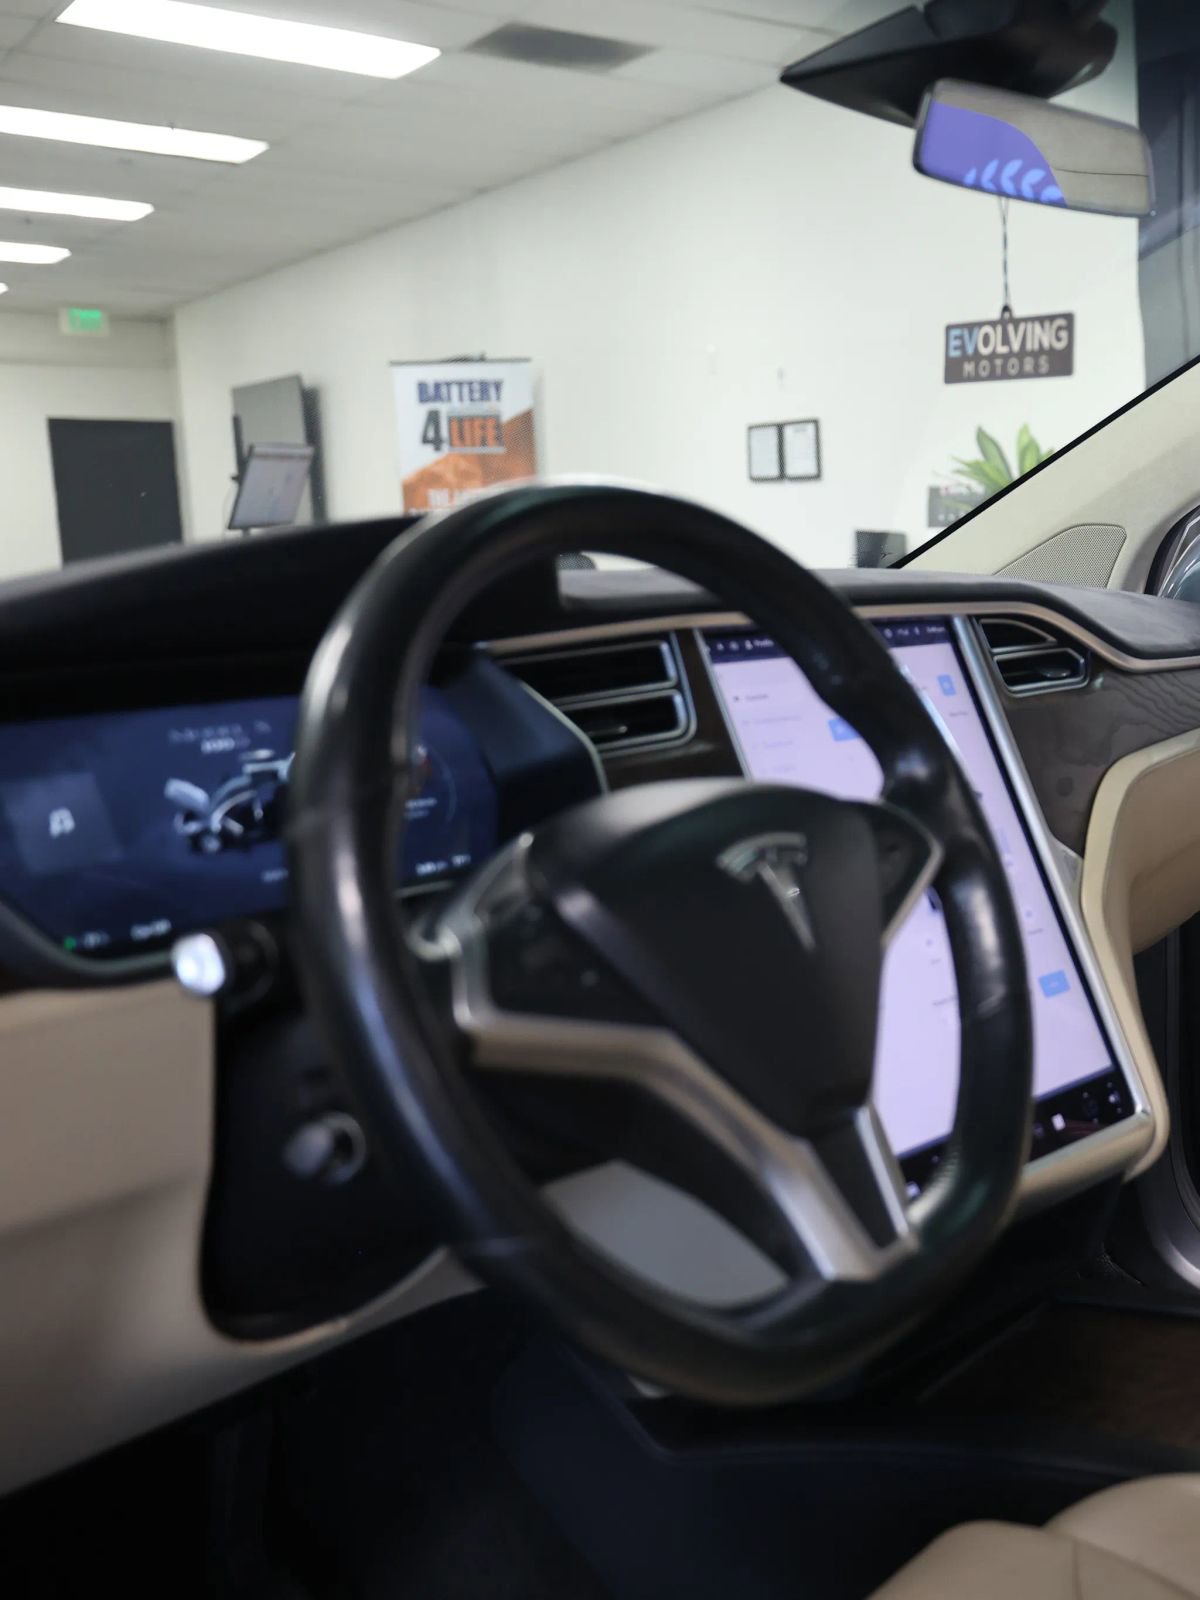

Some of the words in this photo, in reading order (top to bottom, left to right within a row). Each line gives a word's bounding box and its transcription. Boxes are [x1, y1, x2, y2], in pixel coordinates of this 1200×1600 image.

[948, 318, 1069, 357] EVOLVING
[962, 355, 1049, 379] MOTORS
[417, 380, 503, 402] BATTERY
[421, 409, 444, 452] 4
[450, 416, 501, 449] LIFE
